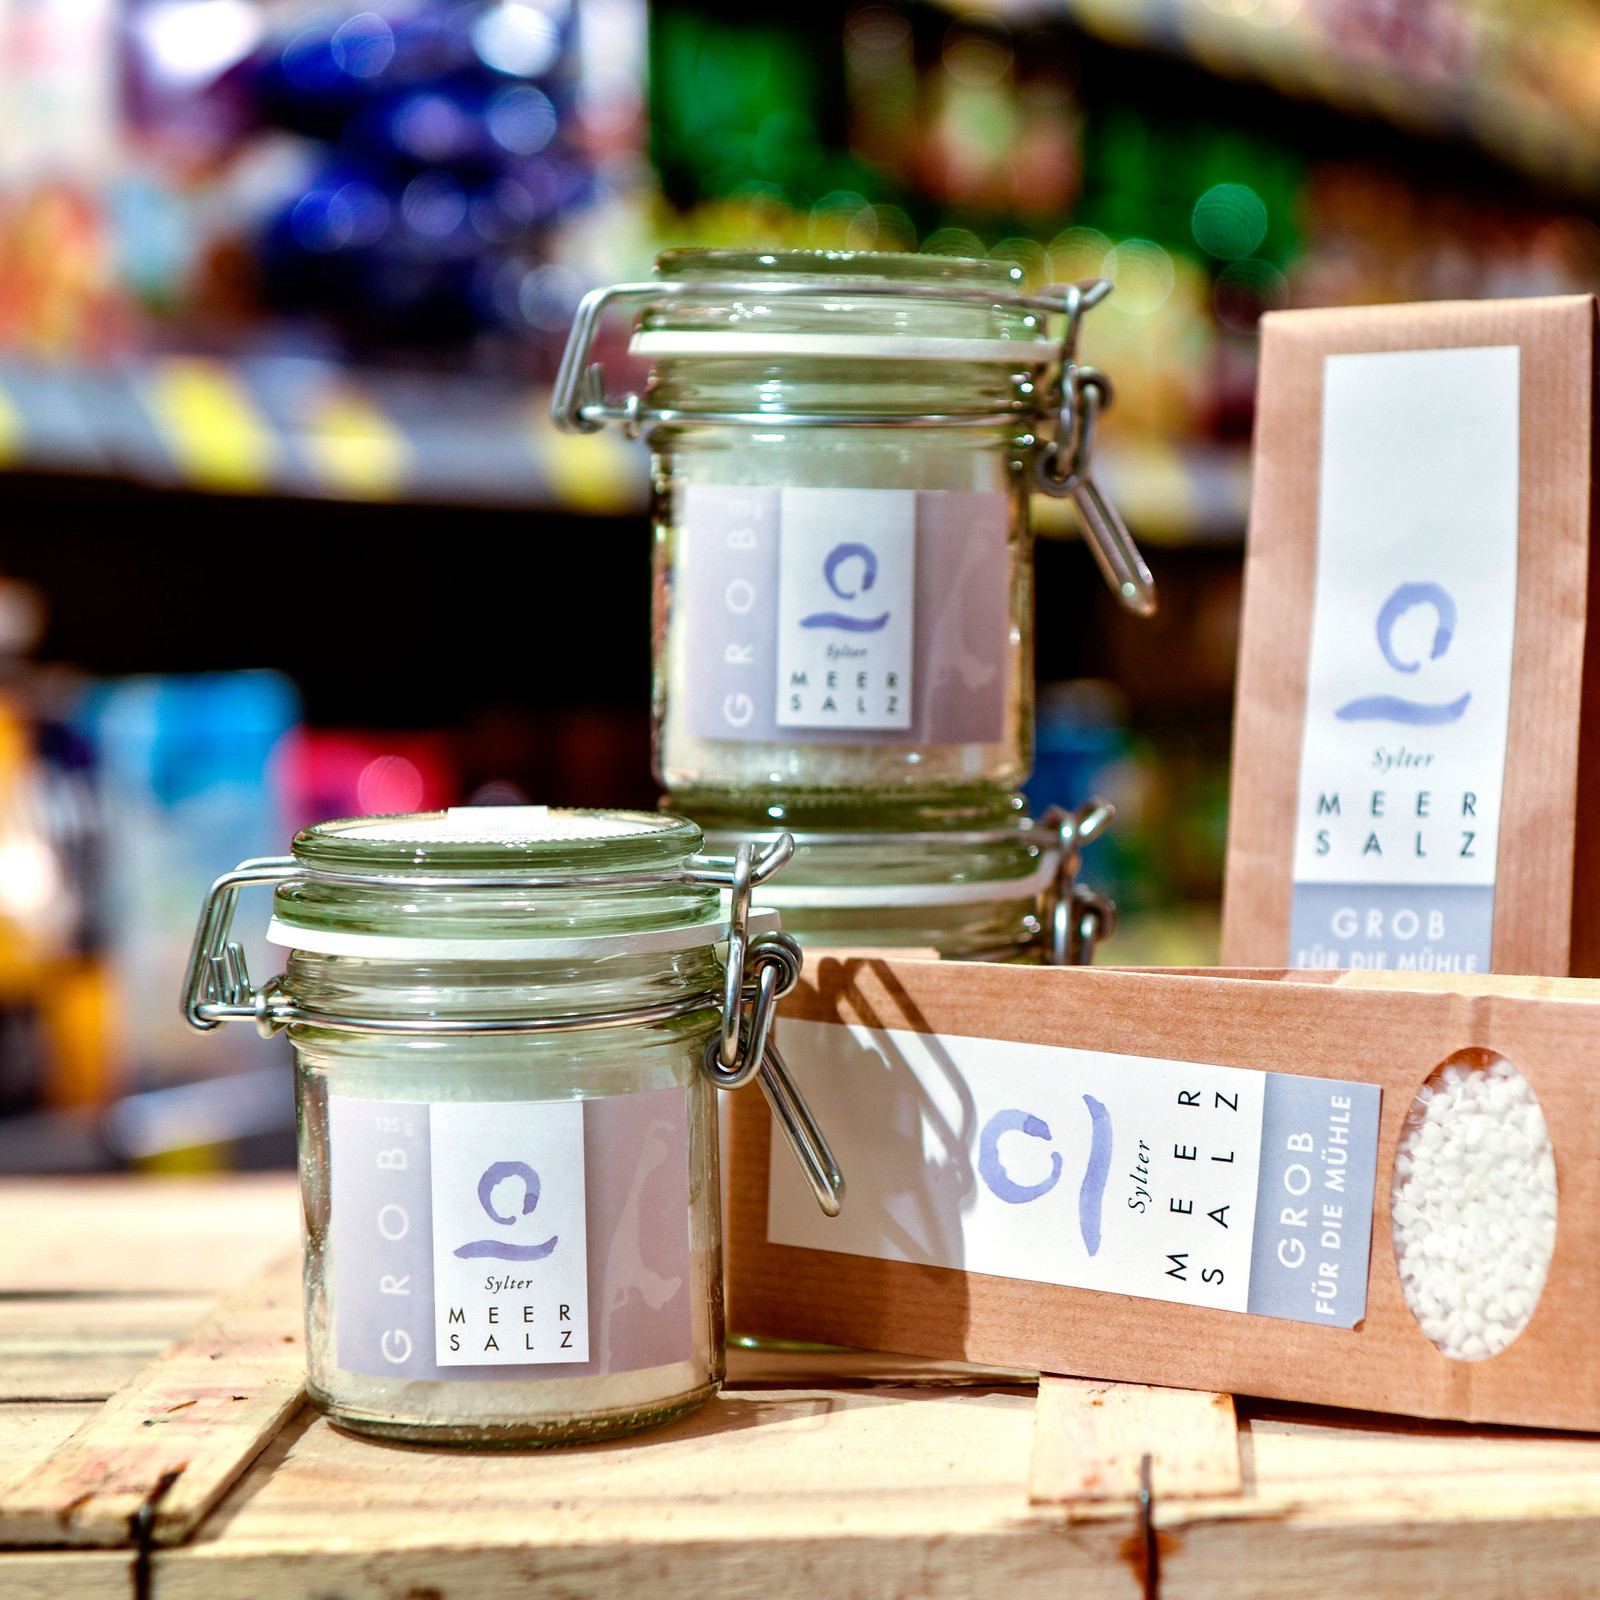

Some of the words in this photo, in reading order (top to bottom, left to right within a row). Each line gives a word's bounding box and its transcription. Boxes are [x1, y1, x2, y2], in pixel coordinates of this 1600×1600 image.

[724, 529, 756, 727] GROB
[790, 671, 898, 688] MEER
[790, 694, 898, 714] SALZ
[1371, 746, 1435, 773] Sylter
[1316, 791, 1477, 818] MEER
[1315, 830, 1476, 858] SALZ
[1331, 907, 1446, 941] GROB
[1297, 943, 1340, 969] FÜR
[1397, 946, 1478, 974] MÜHLE
[1321, 1095, 1352, 1193] MÜHLE
[1127, 1140, 1153, 1214] Sylter
[1165, 1090, 1201, 1281] MEER
[1202, 1092, 1238, 1285] SALZ
[1277, 1132, 1314, 1269] GROB
[1321, 1204, 1343, 1250] DIE
[378, 1149, 413, 1363] GROB
[484, 1275, 534, 1294] Sylter
[1310, 1262, 1340, 1315] FÜR
[448, 1304, 572, 1325] MEER
[449, 1330, 573, 1352] SALZ
